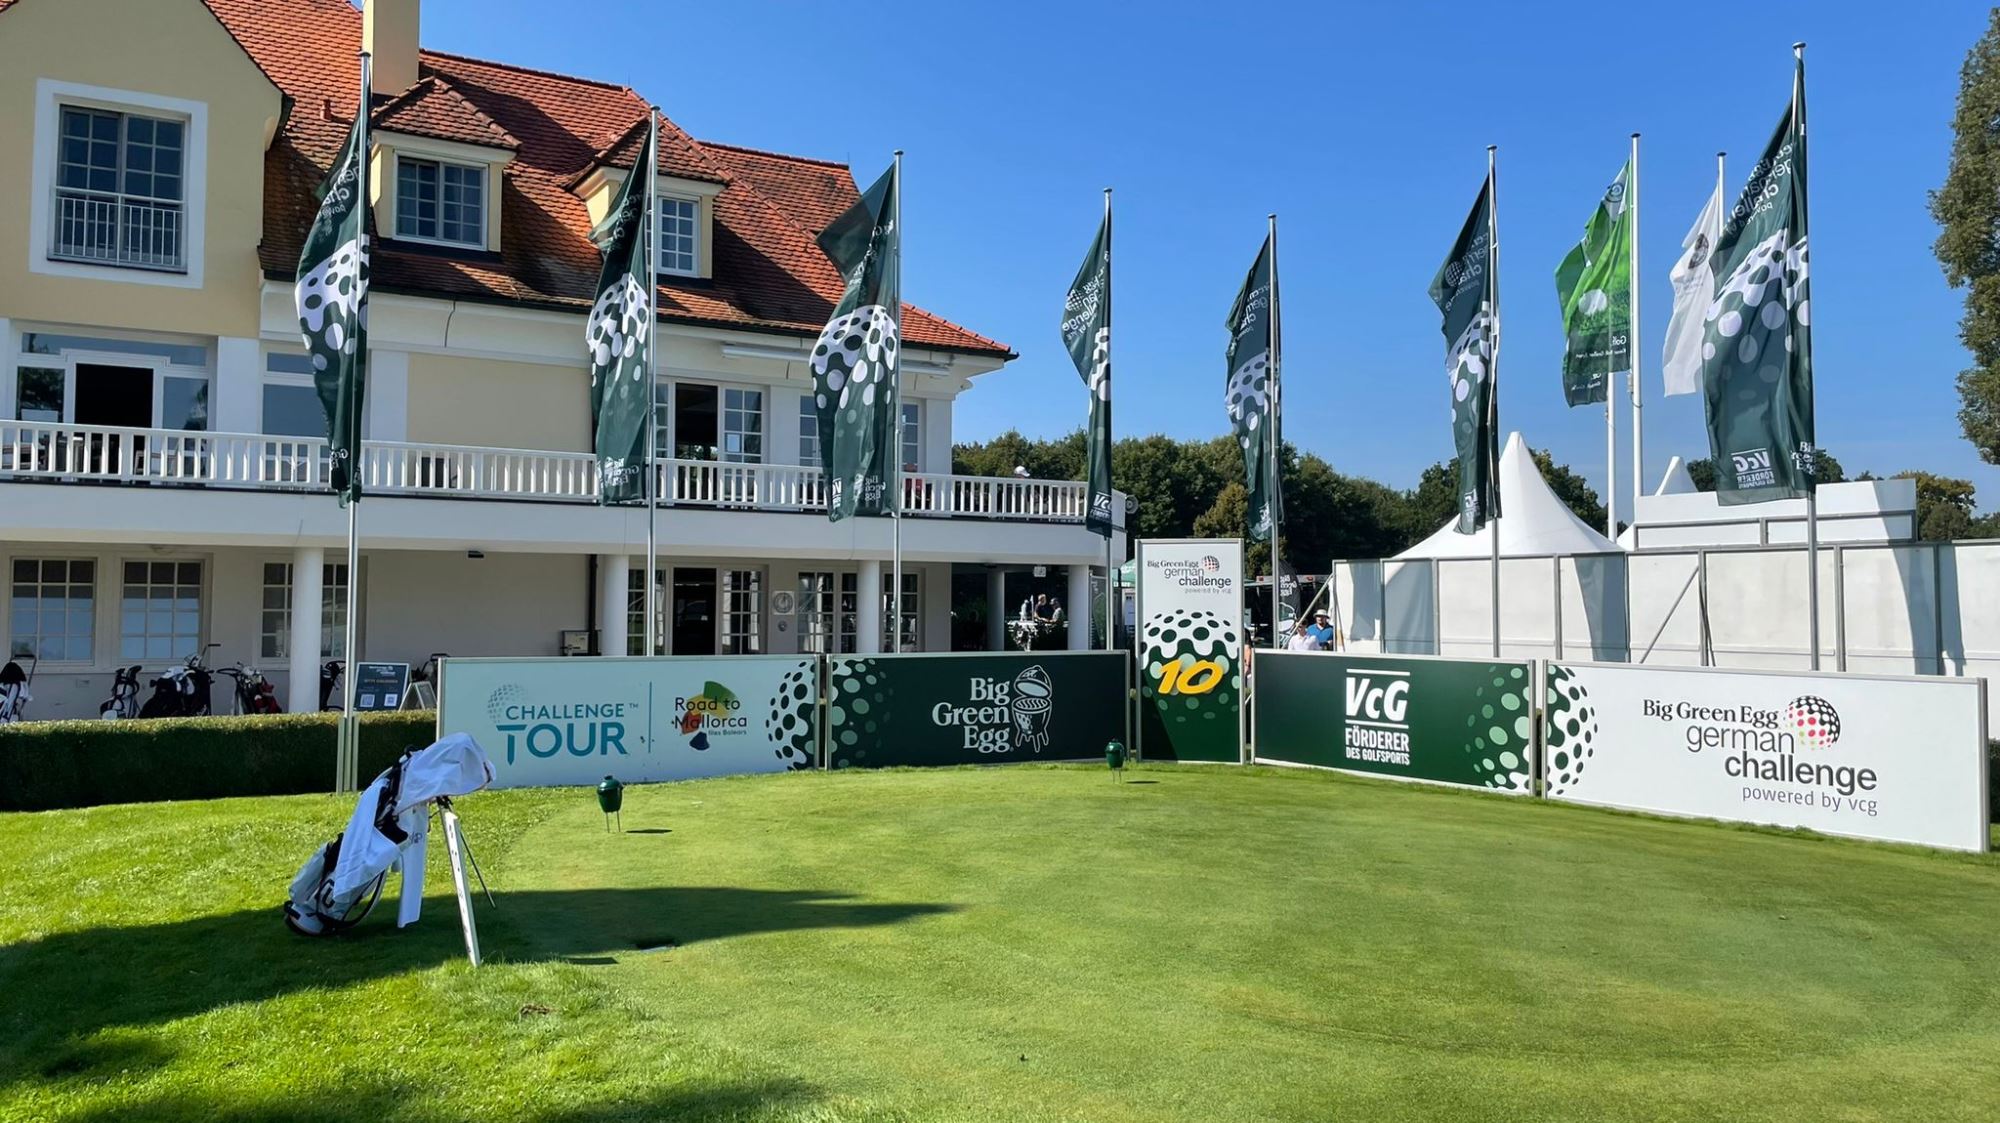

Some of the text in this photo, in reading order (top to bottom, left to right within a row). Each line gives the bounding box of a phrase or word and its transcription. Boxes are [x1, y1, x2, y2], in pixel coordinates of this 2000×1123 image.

[1147, 560, 1199, 568] Big Green Egg
[1164, 567, 1204, 579] german
[1178, 575, 1232, 589] challenge
[1157, 659, 1224, 694] 10
[675, 697, 741, 711] Road to
[969, 677, 1011, 705] Big
[1344, 676, 1410, 722] VcG
[505, 703, 624, 720] CHALLENGE
[674, 714, 748, 729] Mallorca
[931, 702, 1011, 726] Green
[1643, 699, 1779, 729] Big Green Egg
[496, 721, 629, 766] TOUR
[962, 725, 1011, 754] Egg
[1344, 724, 1410, 752] FÖRDERER
[1686, 724, 1795, 753] german
[1345, 747, 1411, 766] DES GOLFSPORTS
[1724, 751, 1878, 796] challenge
[1742, 786, 1878, 817] powered by vcg
